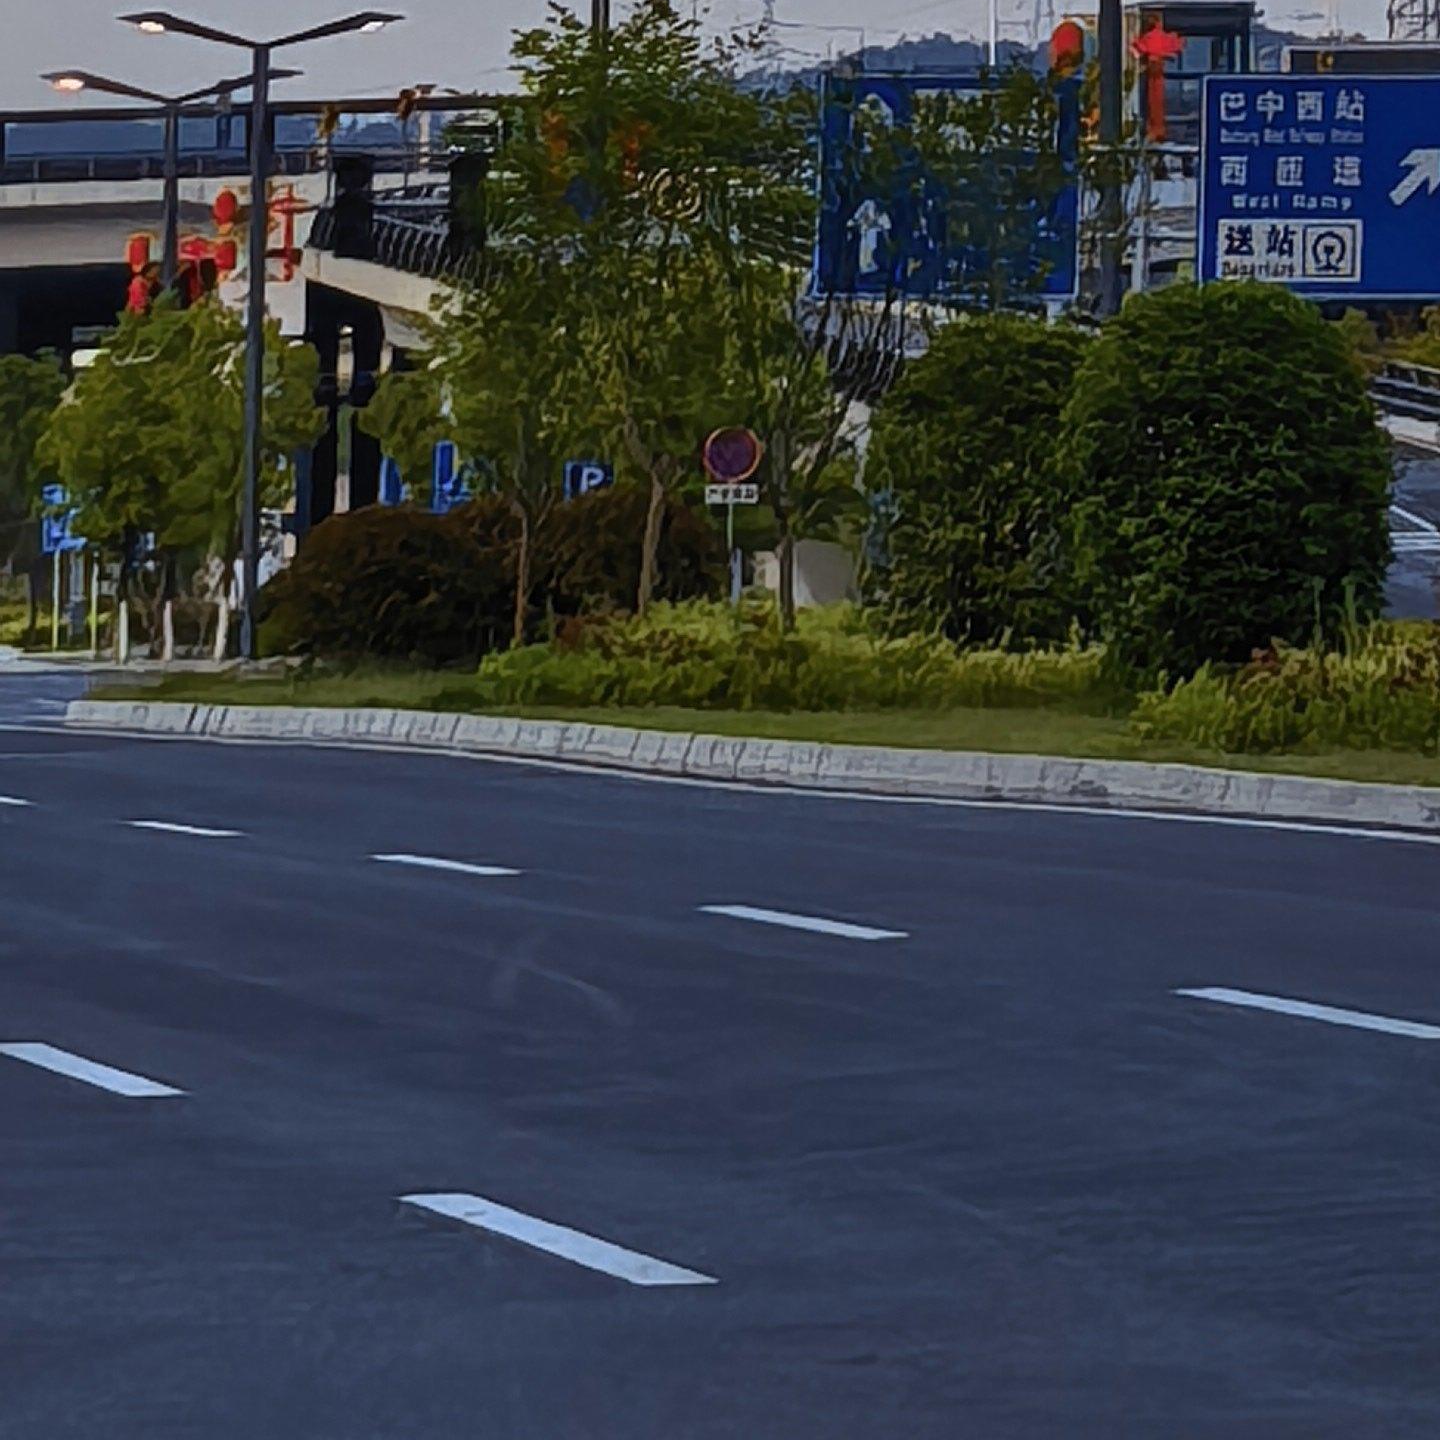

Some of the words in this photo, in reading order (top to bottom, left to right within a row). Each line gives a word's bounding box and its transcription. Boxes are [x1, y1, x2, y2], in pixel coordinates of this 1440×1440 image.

[1220, 89, 1365, 123] 巴中西站
[1224, 224, 1297, 257] 送站
